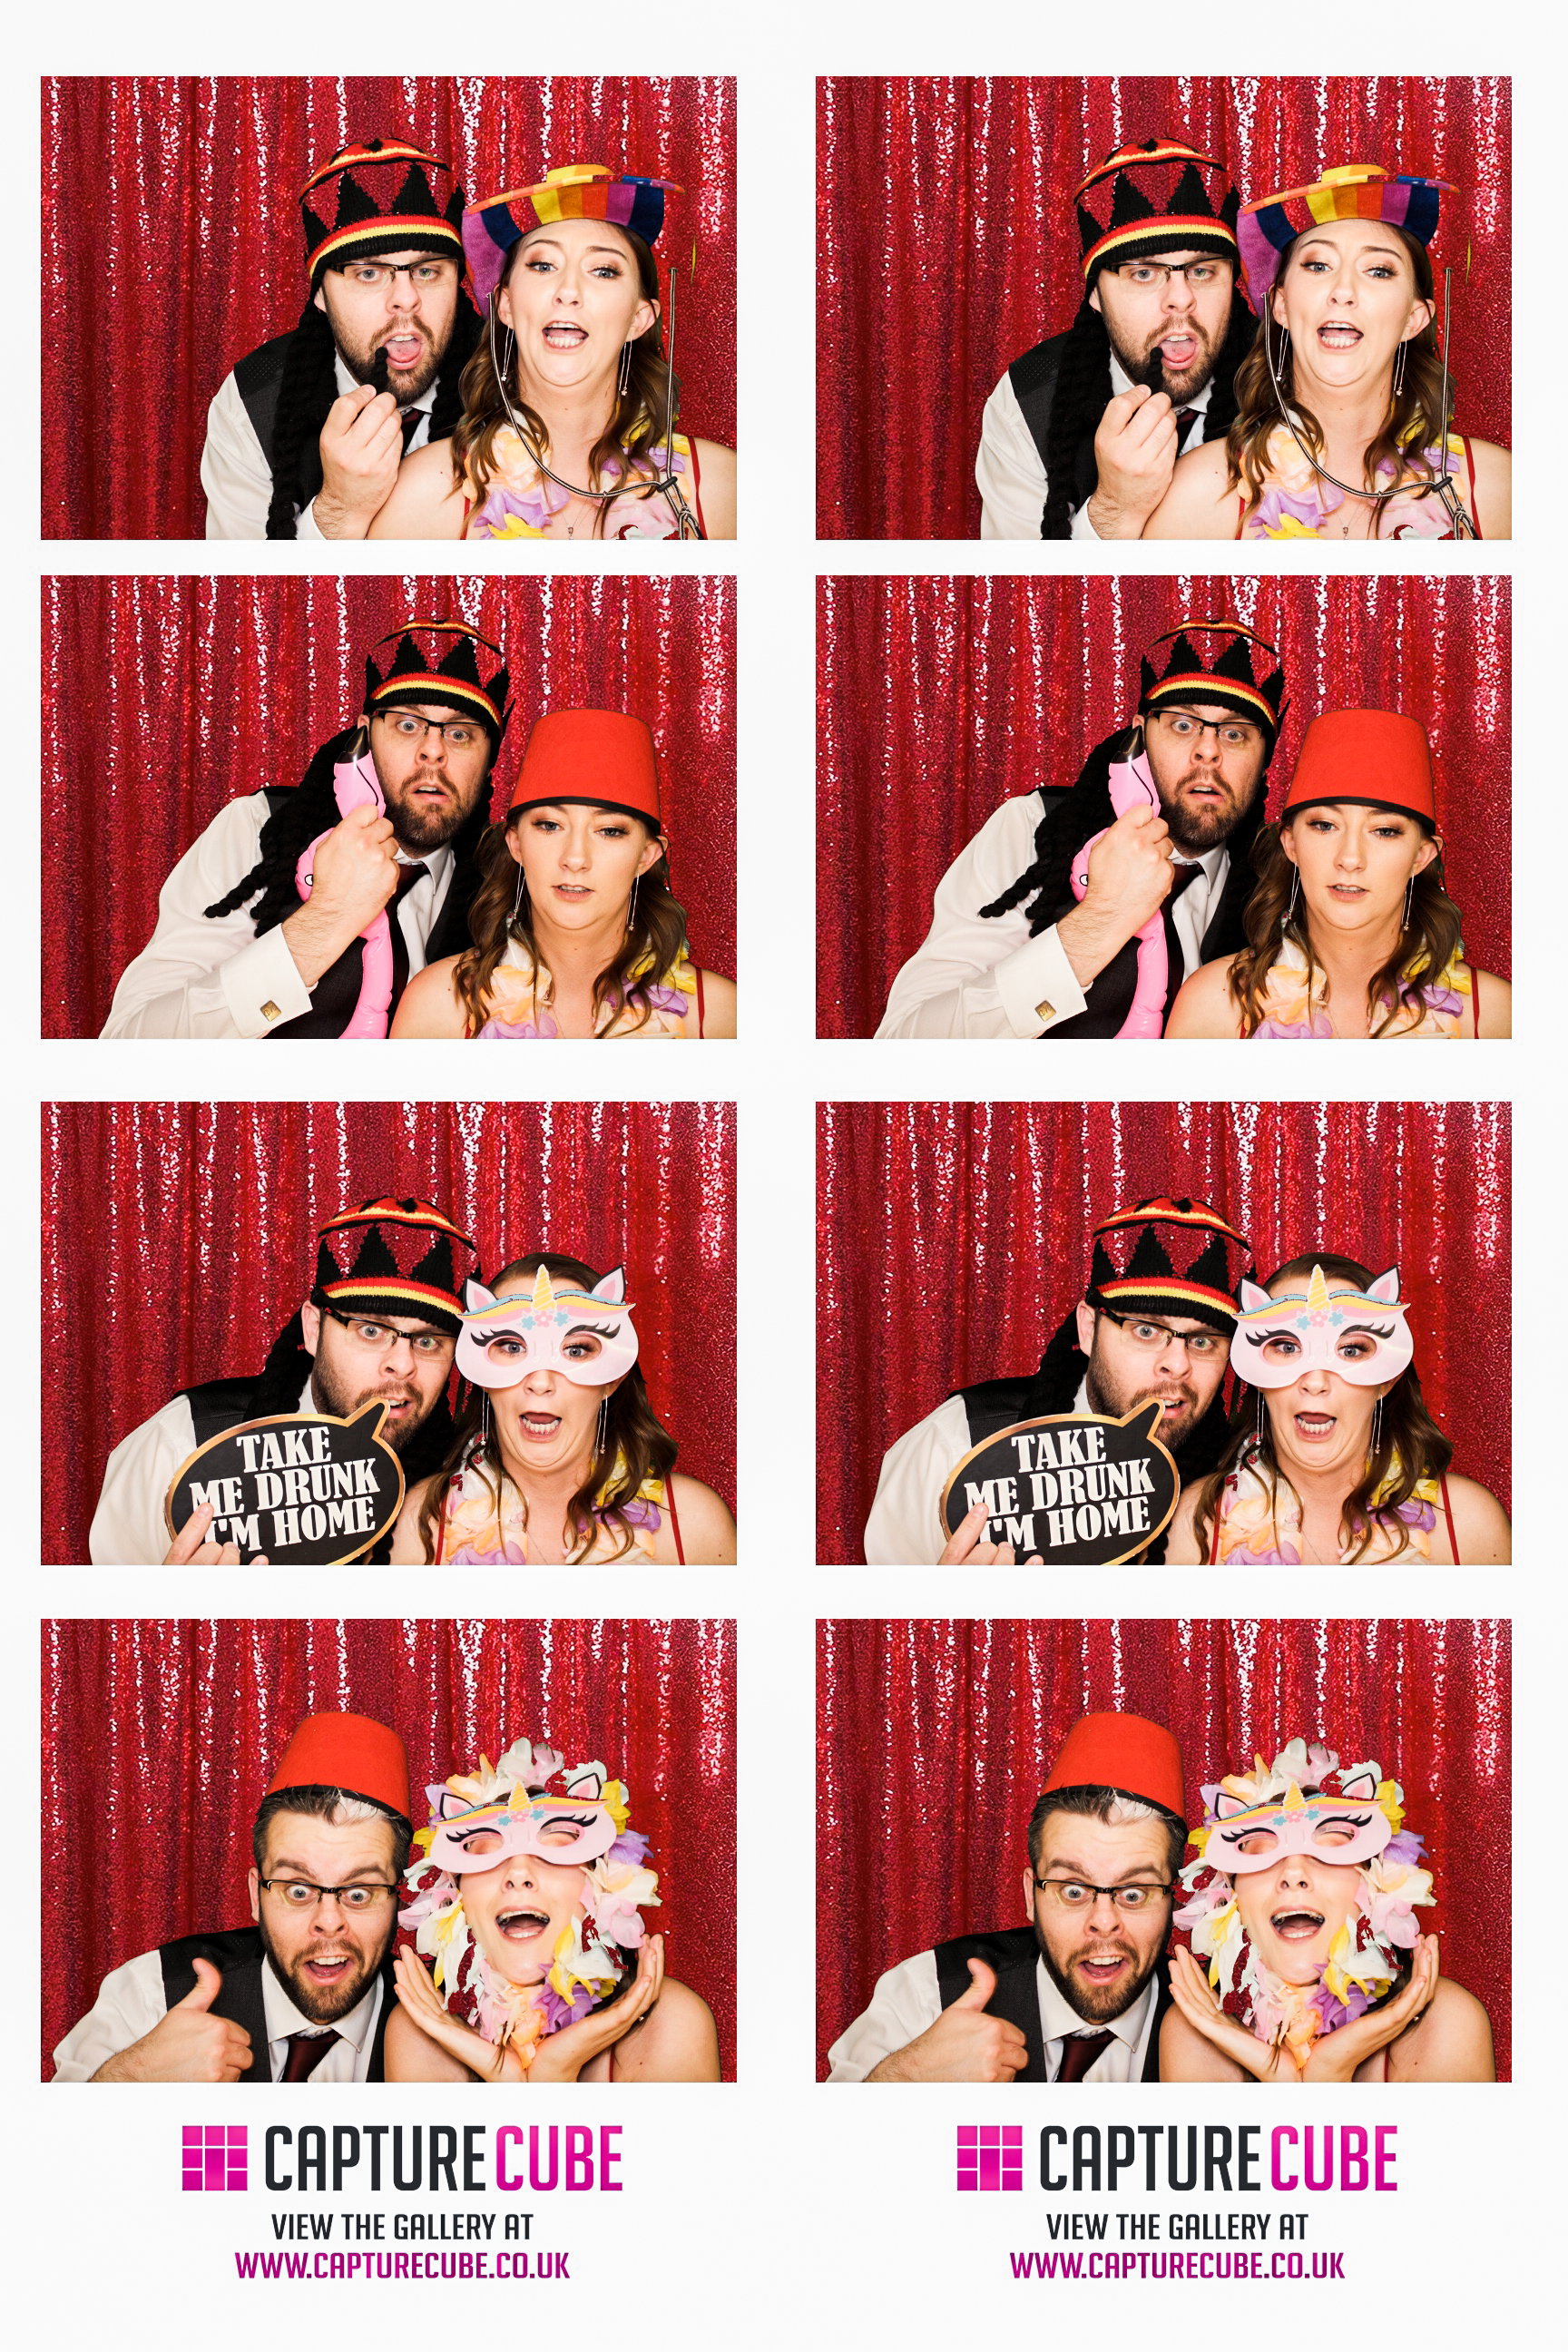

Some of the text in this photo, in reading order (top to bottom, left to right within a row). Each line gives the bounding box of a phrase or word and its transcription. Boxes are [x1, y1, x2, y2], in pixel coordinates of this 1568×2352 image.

[236, 1426, 332, 1473] TAKE
[1011, 1426, 1107, 1473] TAKE
[189, 1458, 380, 1518] ME DRUNK
[964, 1458, 1155, 1518] ME DRUNK
[204, 1496, 376, 1552] I'M HOME
[979, 1496, 1151, 1552] I'M HOME
